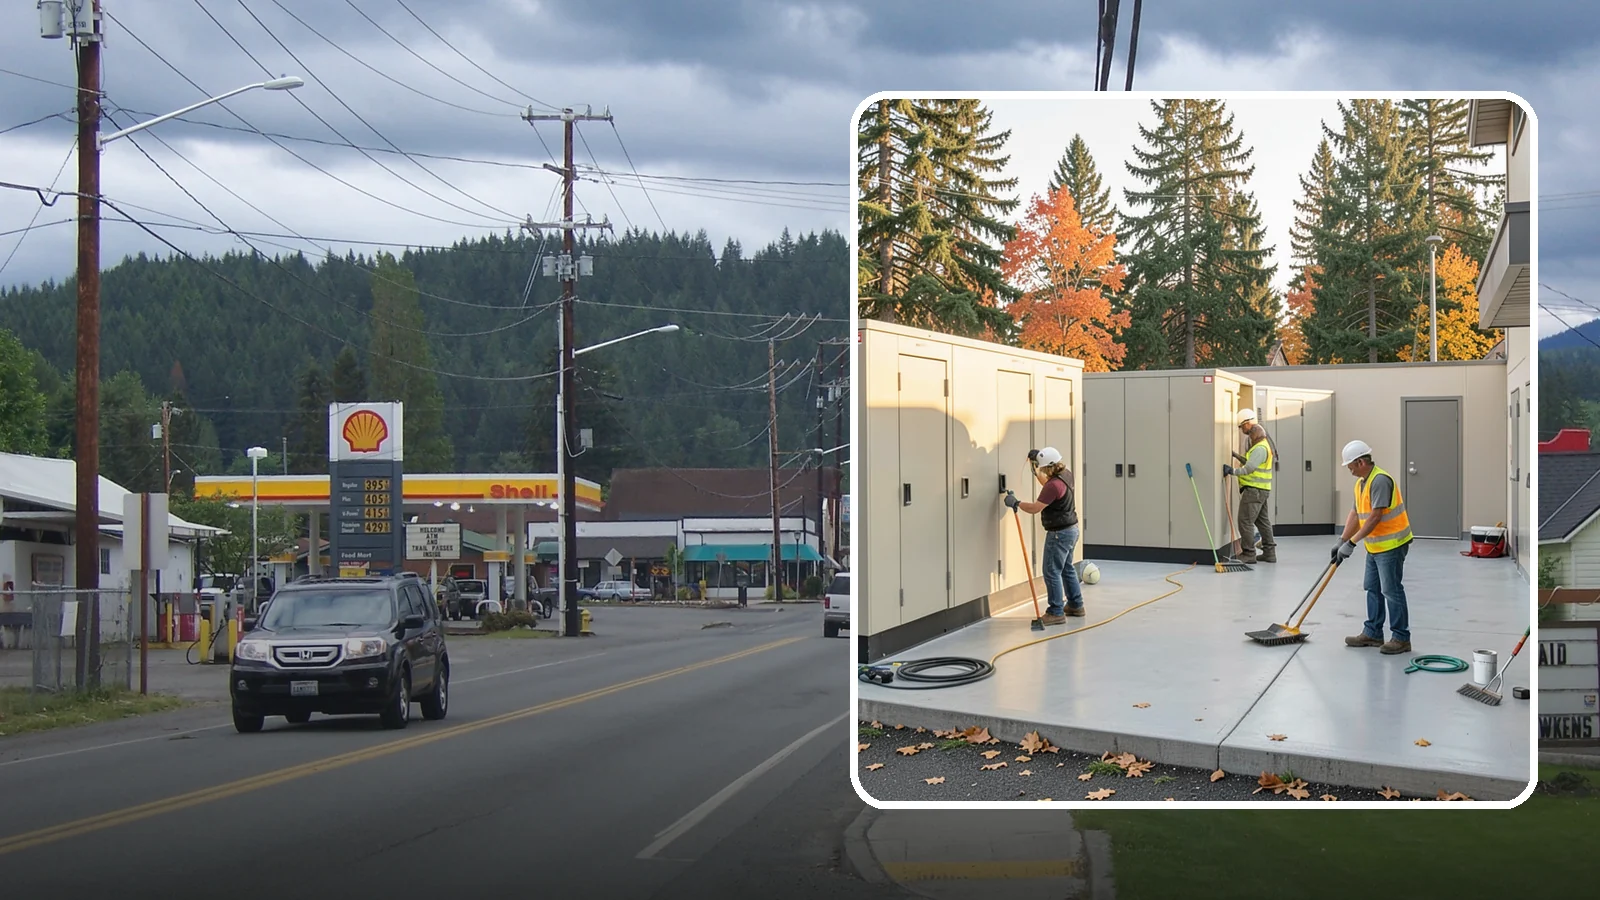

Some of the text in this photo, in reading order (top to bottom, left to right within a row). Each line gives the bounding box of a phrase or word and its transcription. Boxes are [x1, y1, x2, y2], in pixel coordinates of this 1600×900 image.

[366, 480, 383, 490] 395
[490, 484, 547, 499] Shell
[366, 494, 383, 504] 405
[366, 508, 383, 518] 415
[366, 522, 383, 532] 429
[1539, 643, 1567, 666] AID
